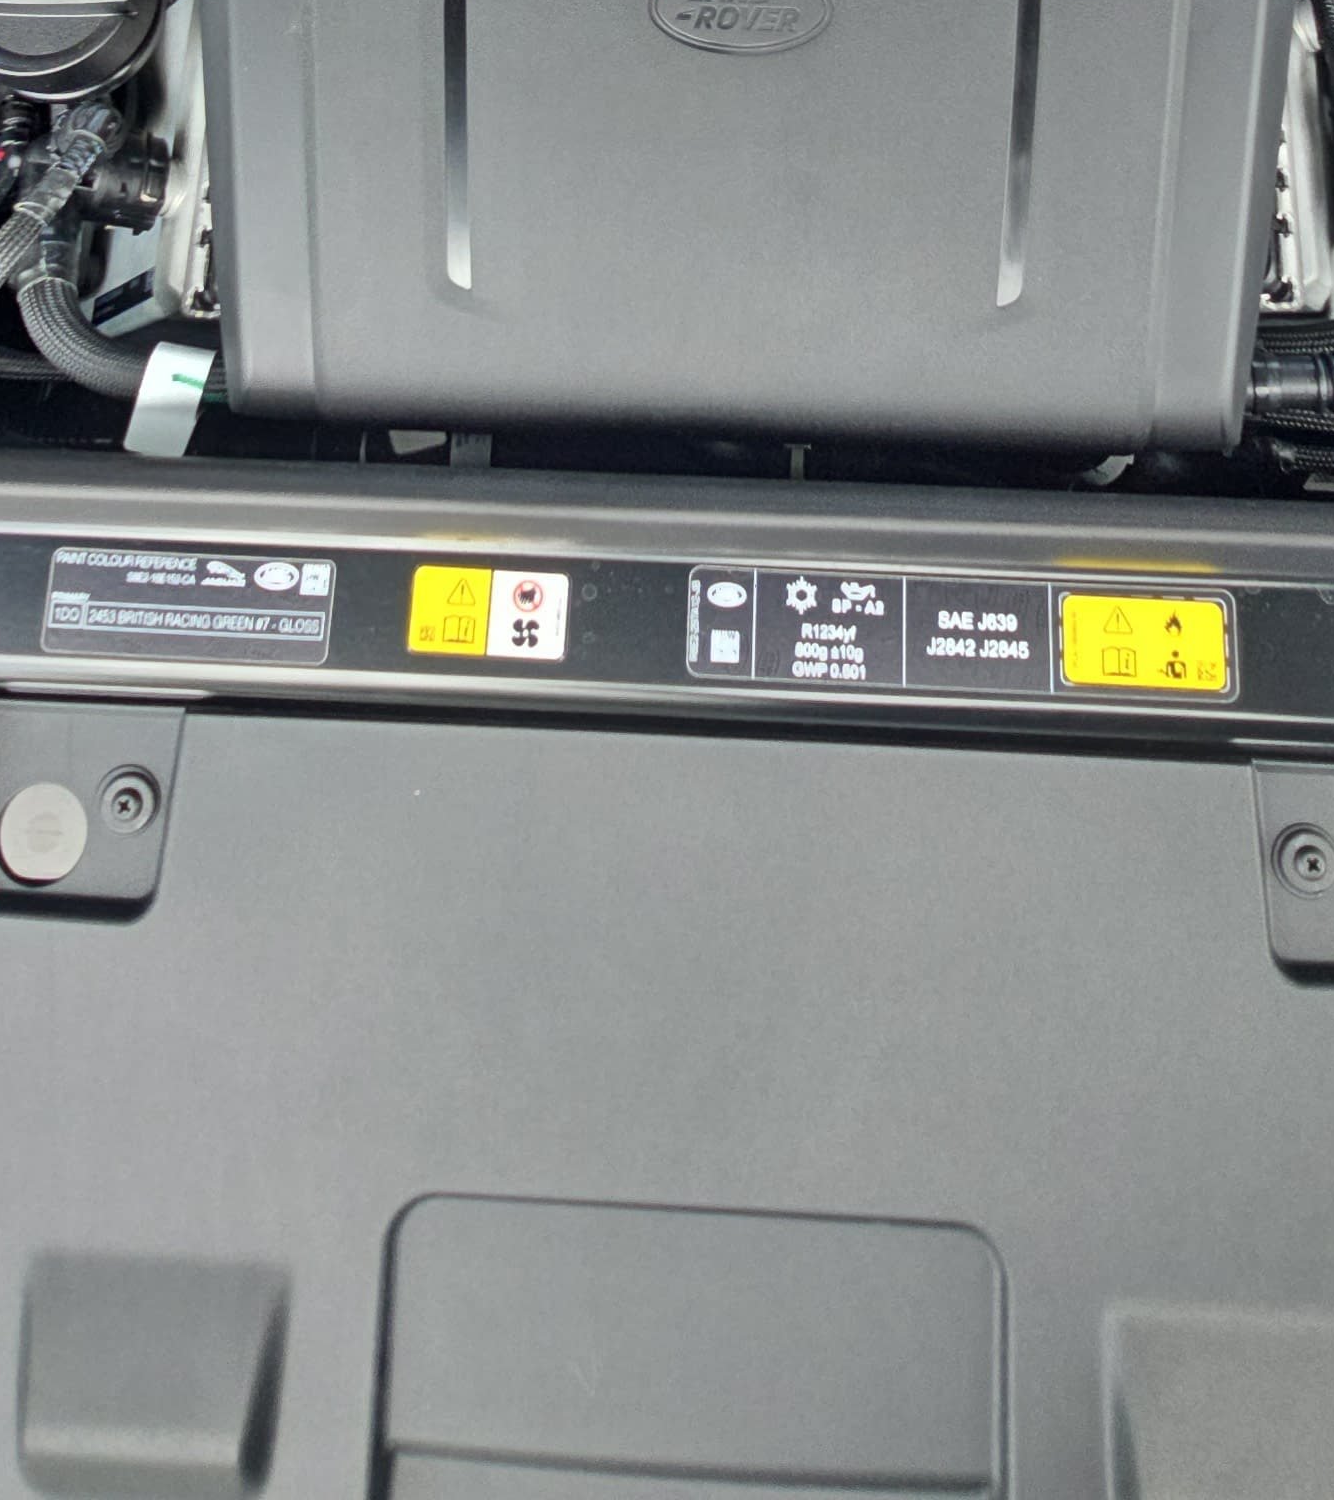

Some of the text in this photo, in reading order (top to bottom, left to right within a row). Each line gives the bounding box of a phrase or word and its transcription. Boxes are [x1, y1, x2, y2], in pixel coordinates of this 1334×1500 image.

[693, 5, 801, 32] ROVER
[56, 551, 198, 572] PAINT COLOUR REFERENCE
[864, 600, 885, 616] A2
[88, 608, 116, 625] 2453
[117, 609, 164, 627] BRITISH
[164, 611, 212, 630] RACING
[212, 614, 255, 631] GREEN
[278, 617, 320, 635] GLOSS
[937, 610, 1018, 632] SAE J639
[800, 622, 857, 644] R1234yf
[926, 636, 1030, 660] J2842 J2845
[792, 660, 828, 678] GWP
